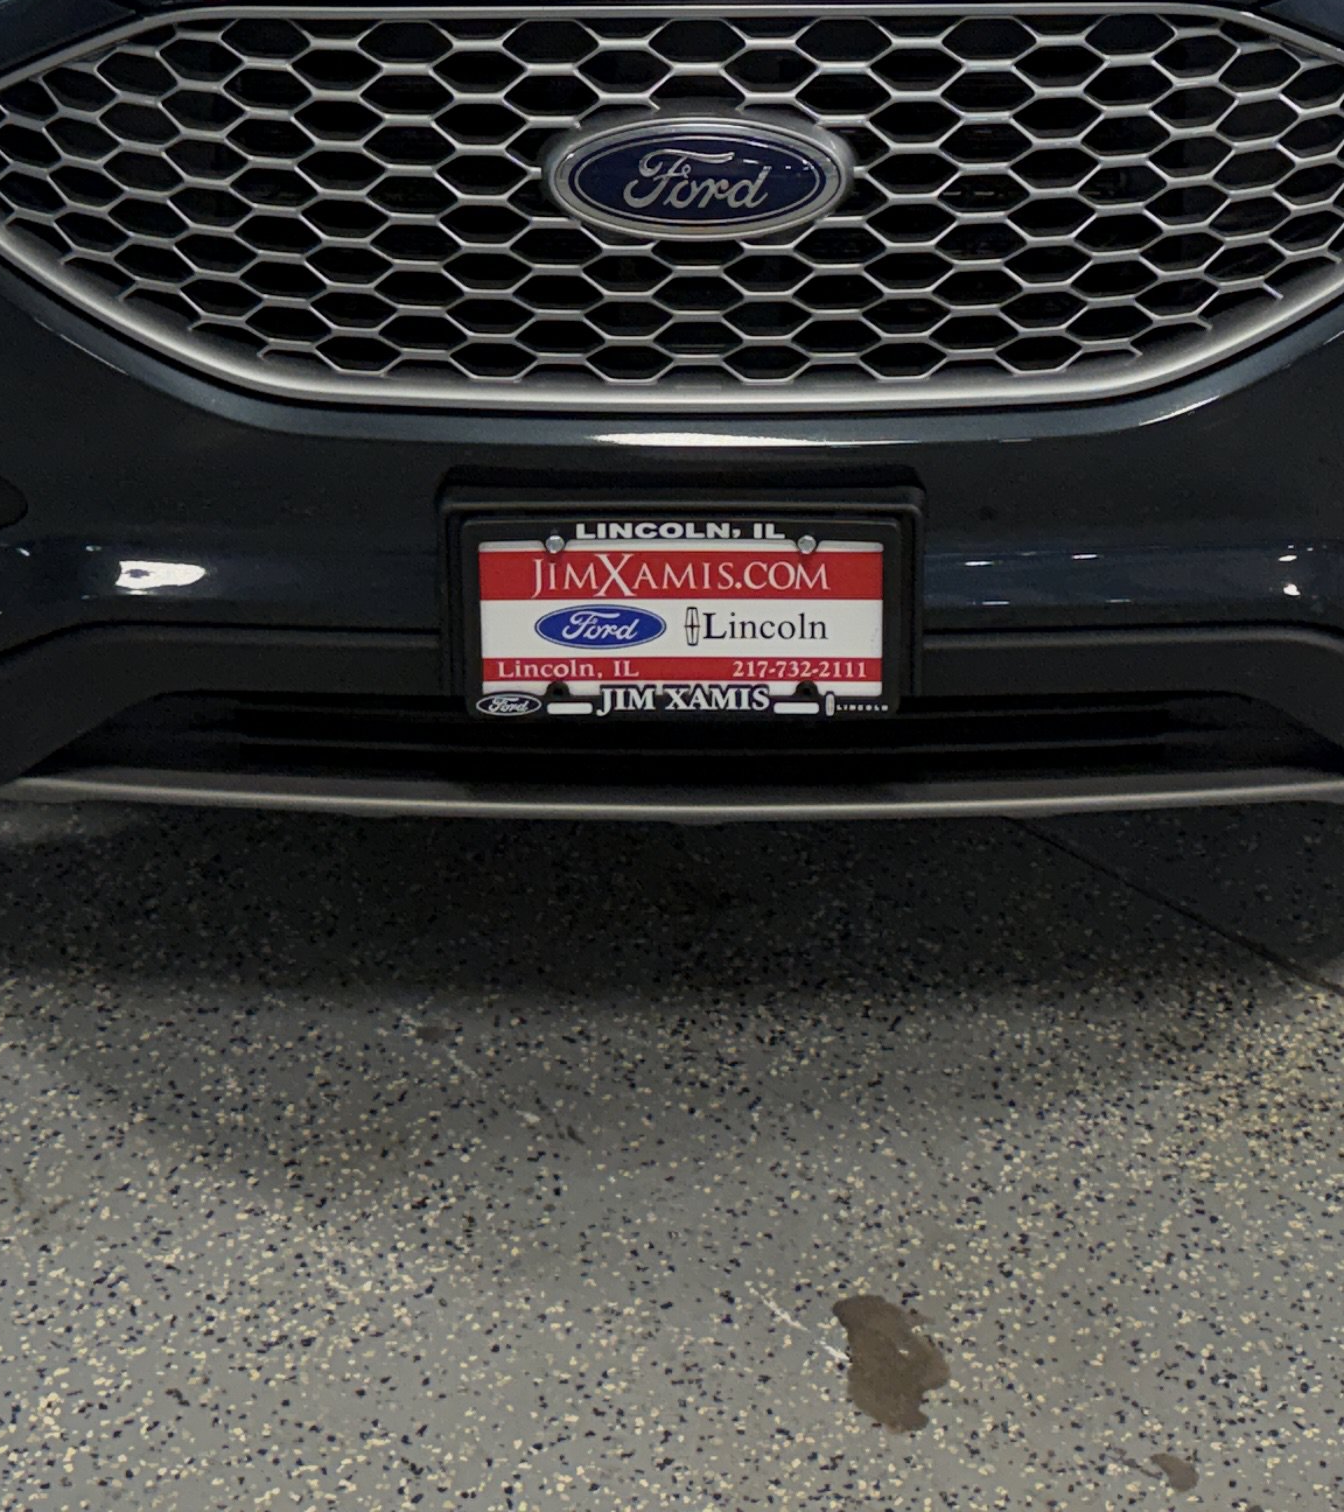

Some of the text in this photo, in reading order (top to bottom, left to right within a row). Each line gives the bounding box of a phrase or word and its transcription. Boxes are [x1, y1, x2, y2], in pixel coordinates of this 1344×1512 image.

[623, 148, 772, 208] Ford
[576, 522, 785, 540] LINCOLN, IL
[532, 554, 829, 598] JIMXAMIS.COM
[562, 610, 638, 641] Ford
[703, 612, 828, 640] Lincoln
[498, 659, 639, 679] Lincoln, IL
[733, 660, 867, 679] 217-732-2111
[487, 697, 529, 714] Ford
[596, 688, 770, 716] JIM XAMIS
